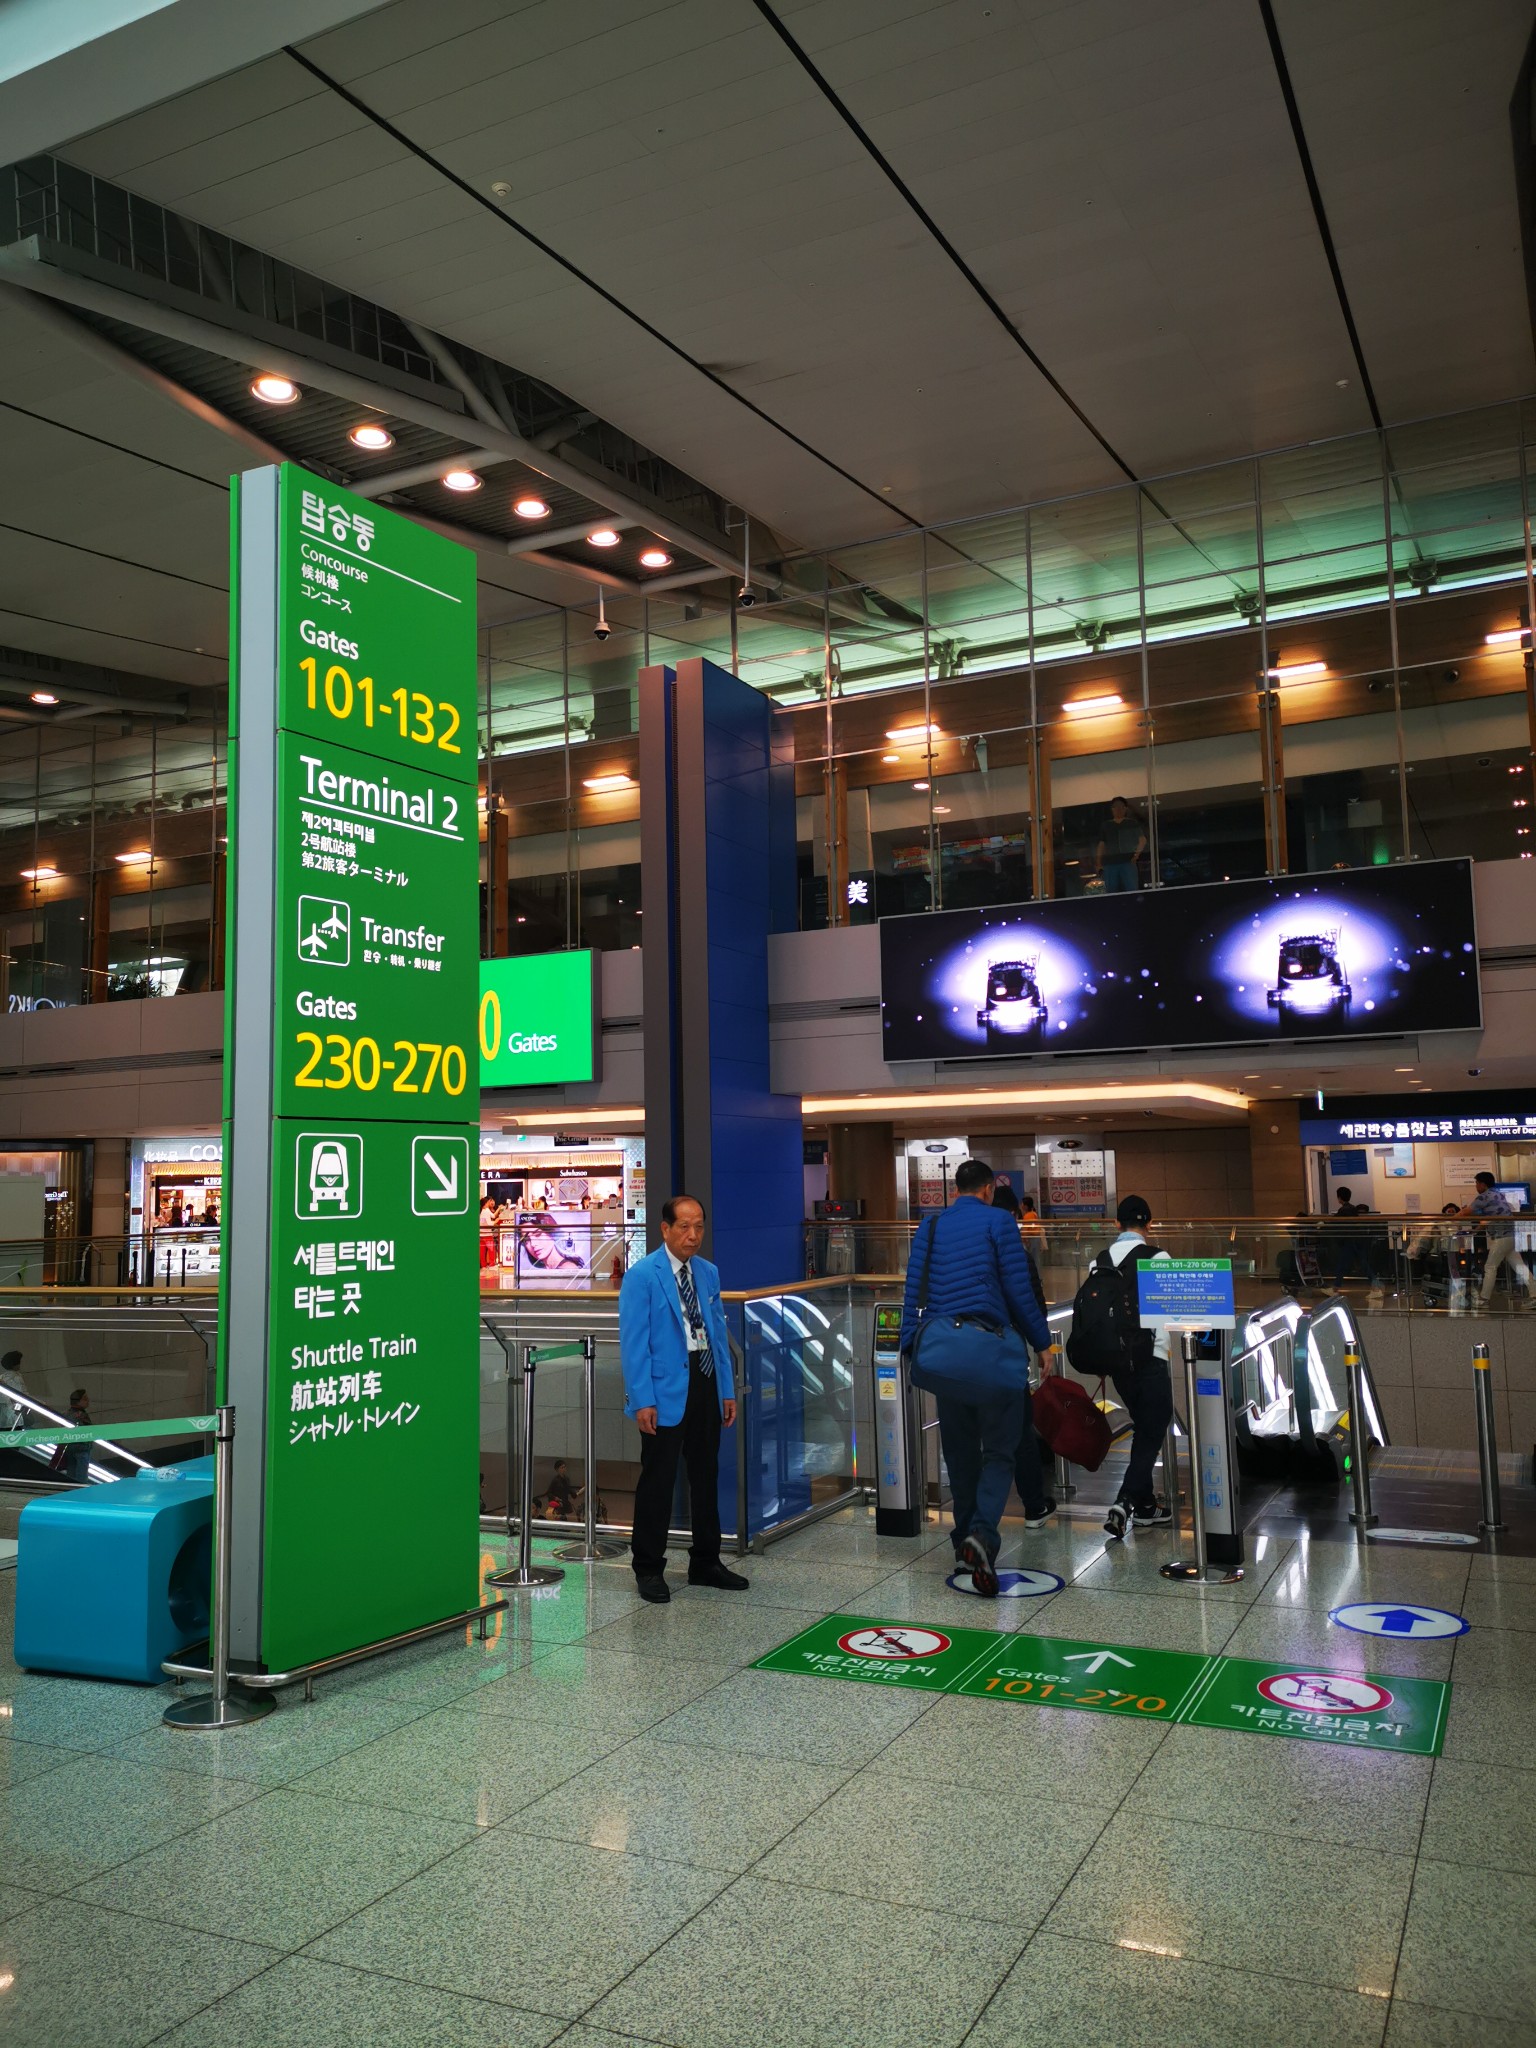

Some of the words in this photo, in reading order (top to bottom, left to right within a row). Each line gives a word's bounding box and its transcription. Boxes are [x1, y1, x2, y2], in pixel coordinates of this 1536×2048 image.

[301, 490, 375, 552] 탑승동
[301, 543, 368, 583] Concourse
[301, 562, 339, 591] 候机楼
[301, 583, 352, 614] コンコース
[300, 619, 359, 660] Gates
[299, 656, 461, 754] 101-132
[300, 755, 433, 825] Terminal
[442, 796, 458, 831] 2
[301, 811, 375, 844] 제2여객터미널
[301, 832, 357, 858] 2号航站楼
[301, 851, 409, 887] 第2旅客ターミナル
[848, 880, 868, 904] 美
[361, 916, 445, 953] Transfer
[296, 991, 357, 1021] Gates
[508, 1032, 558, 1054] Gates
[295, 1032, 467, 1096] 230-270
[1460, 1128, 1490, 1137] Delivery
[1491, 1127, 1511, 1135] Point
[1512, 1127, 1520, 1135] of
[293, 1240, 395, 1276] 셔틀트레인
[1201, 1261, 1218, 1270] Only
[294, 1285, 335, 1319] 타는
[342, 1282, 362, 1316] 곳
[291, 1339, 364, 1370] Shuttle
[369, 1333, 417, 1359] Train
[291, 1370, 382, 1412] 航站列车
[26, 1434, 60, 1443] Incheon
[62, 1432, 93, 1441] Airport
[289, 1401, 421, 1445] シャトル・トレイン
[801, 1652, 937, 1677] 카트진입금지
[813, 1664, 842, 1673] No
[848, 1668, 901, 1681] Carts
[996, 1667, 1072, 1684] Gates
[984, 1677, 1167, 1712] 101-270
[1230, 1704, 1403, 1736] 카트진입금지
[1258, 1718, 1293, 1731] No
[1302, 1725, 1368, 1740] Carts
